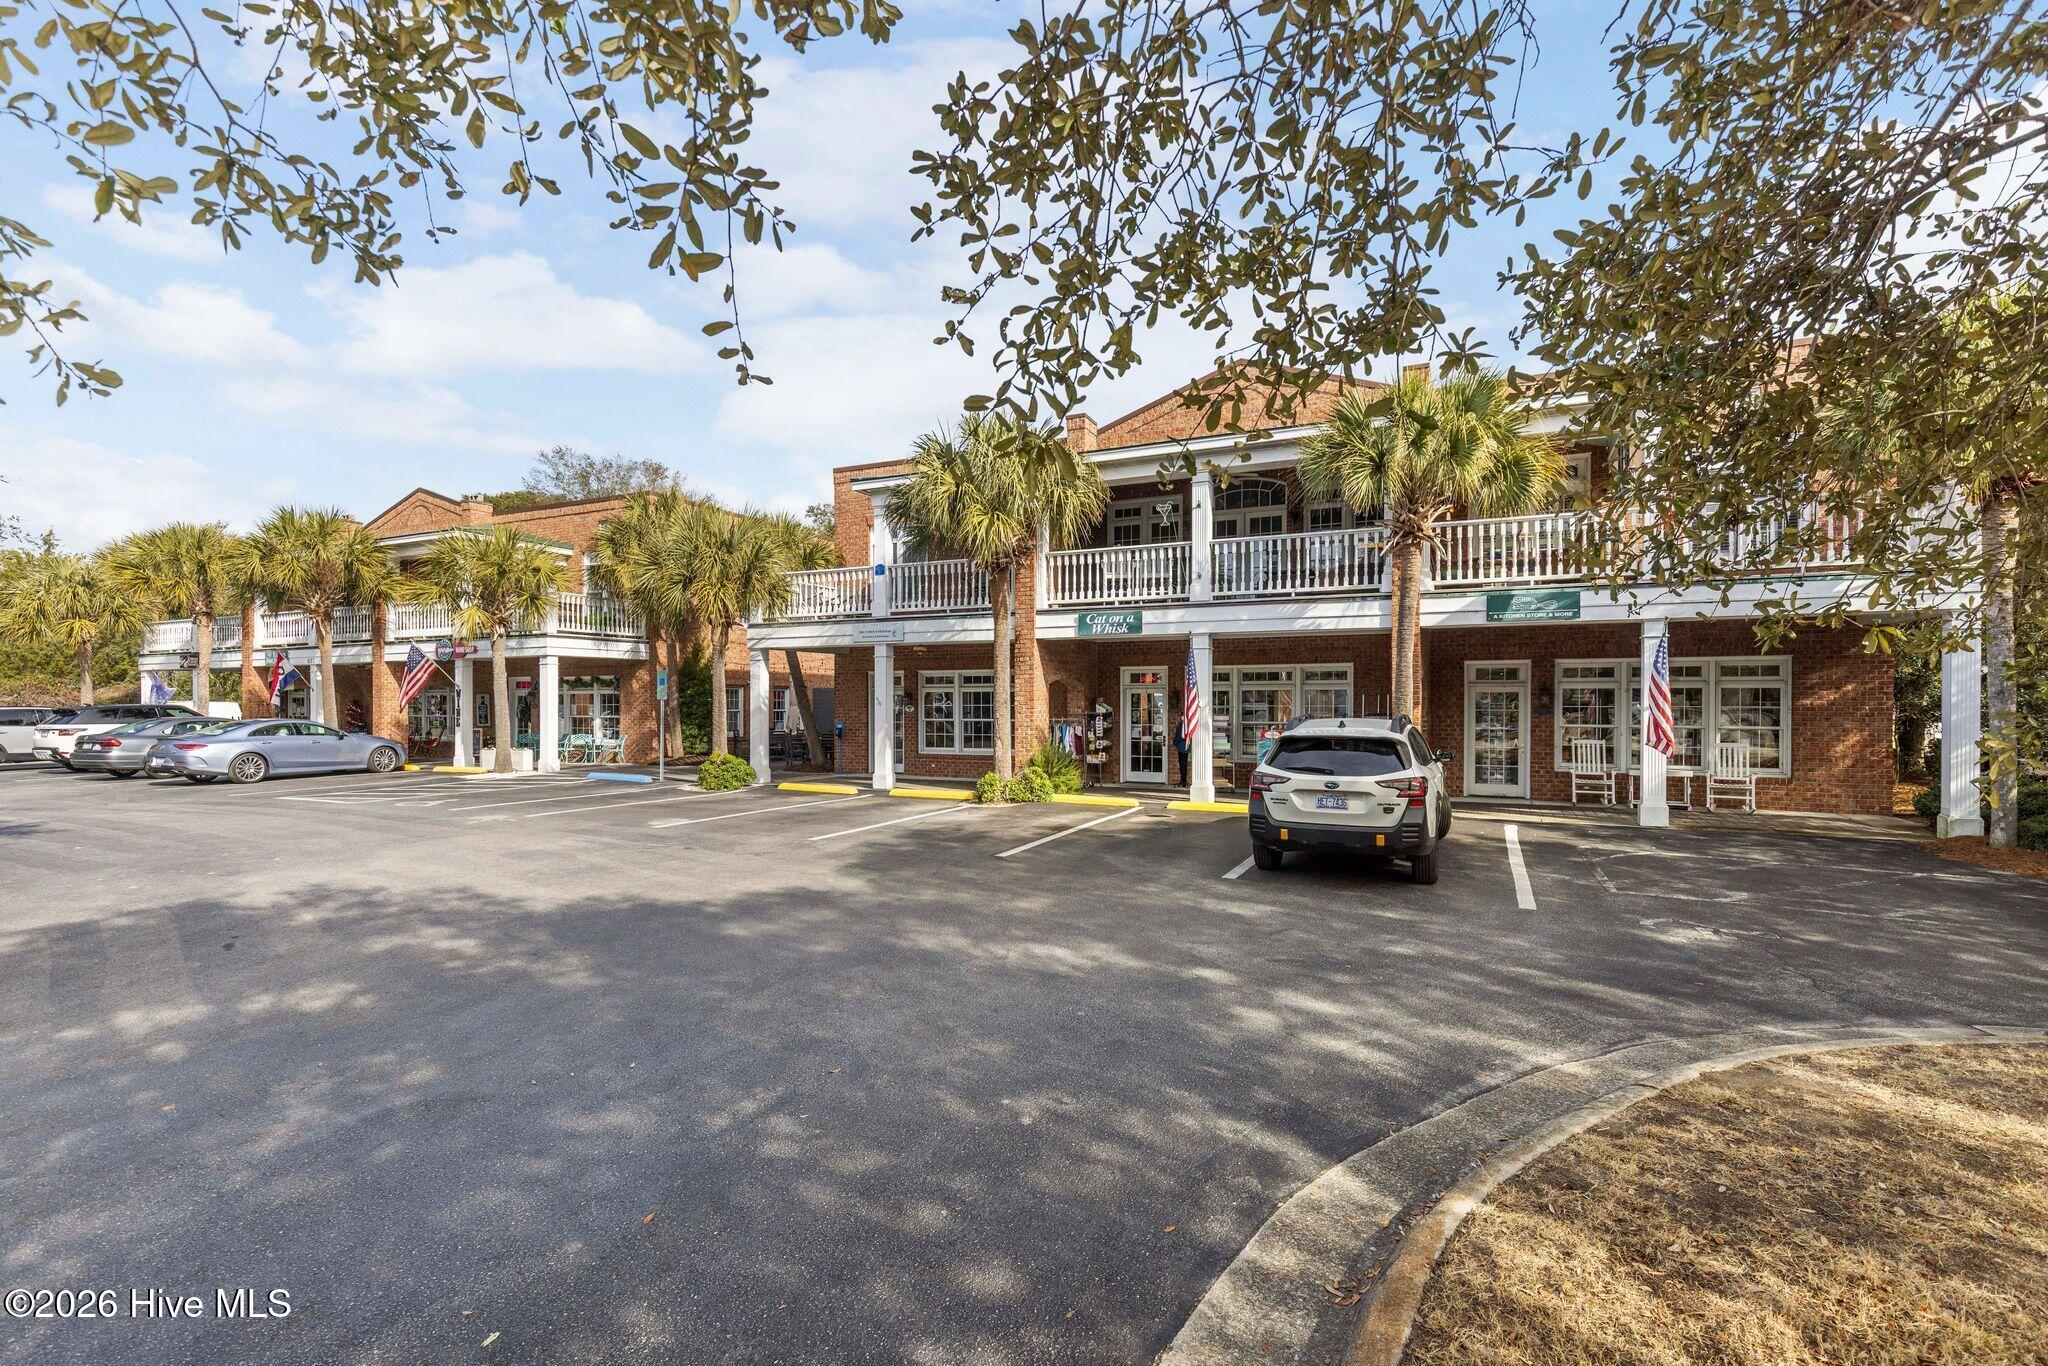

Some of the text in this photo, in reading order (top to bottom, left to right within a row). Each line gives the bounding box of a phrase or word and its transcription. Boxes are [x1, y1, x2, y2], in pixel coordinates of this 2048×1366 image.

[1086, 613, 1107, 624] Cat
[1109, 615, 1123, 623] on
[1092, 623, 1129, 634] Whisk
